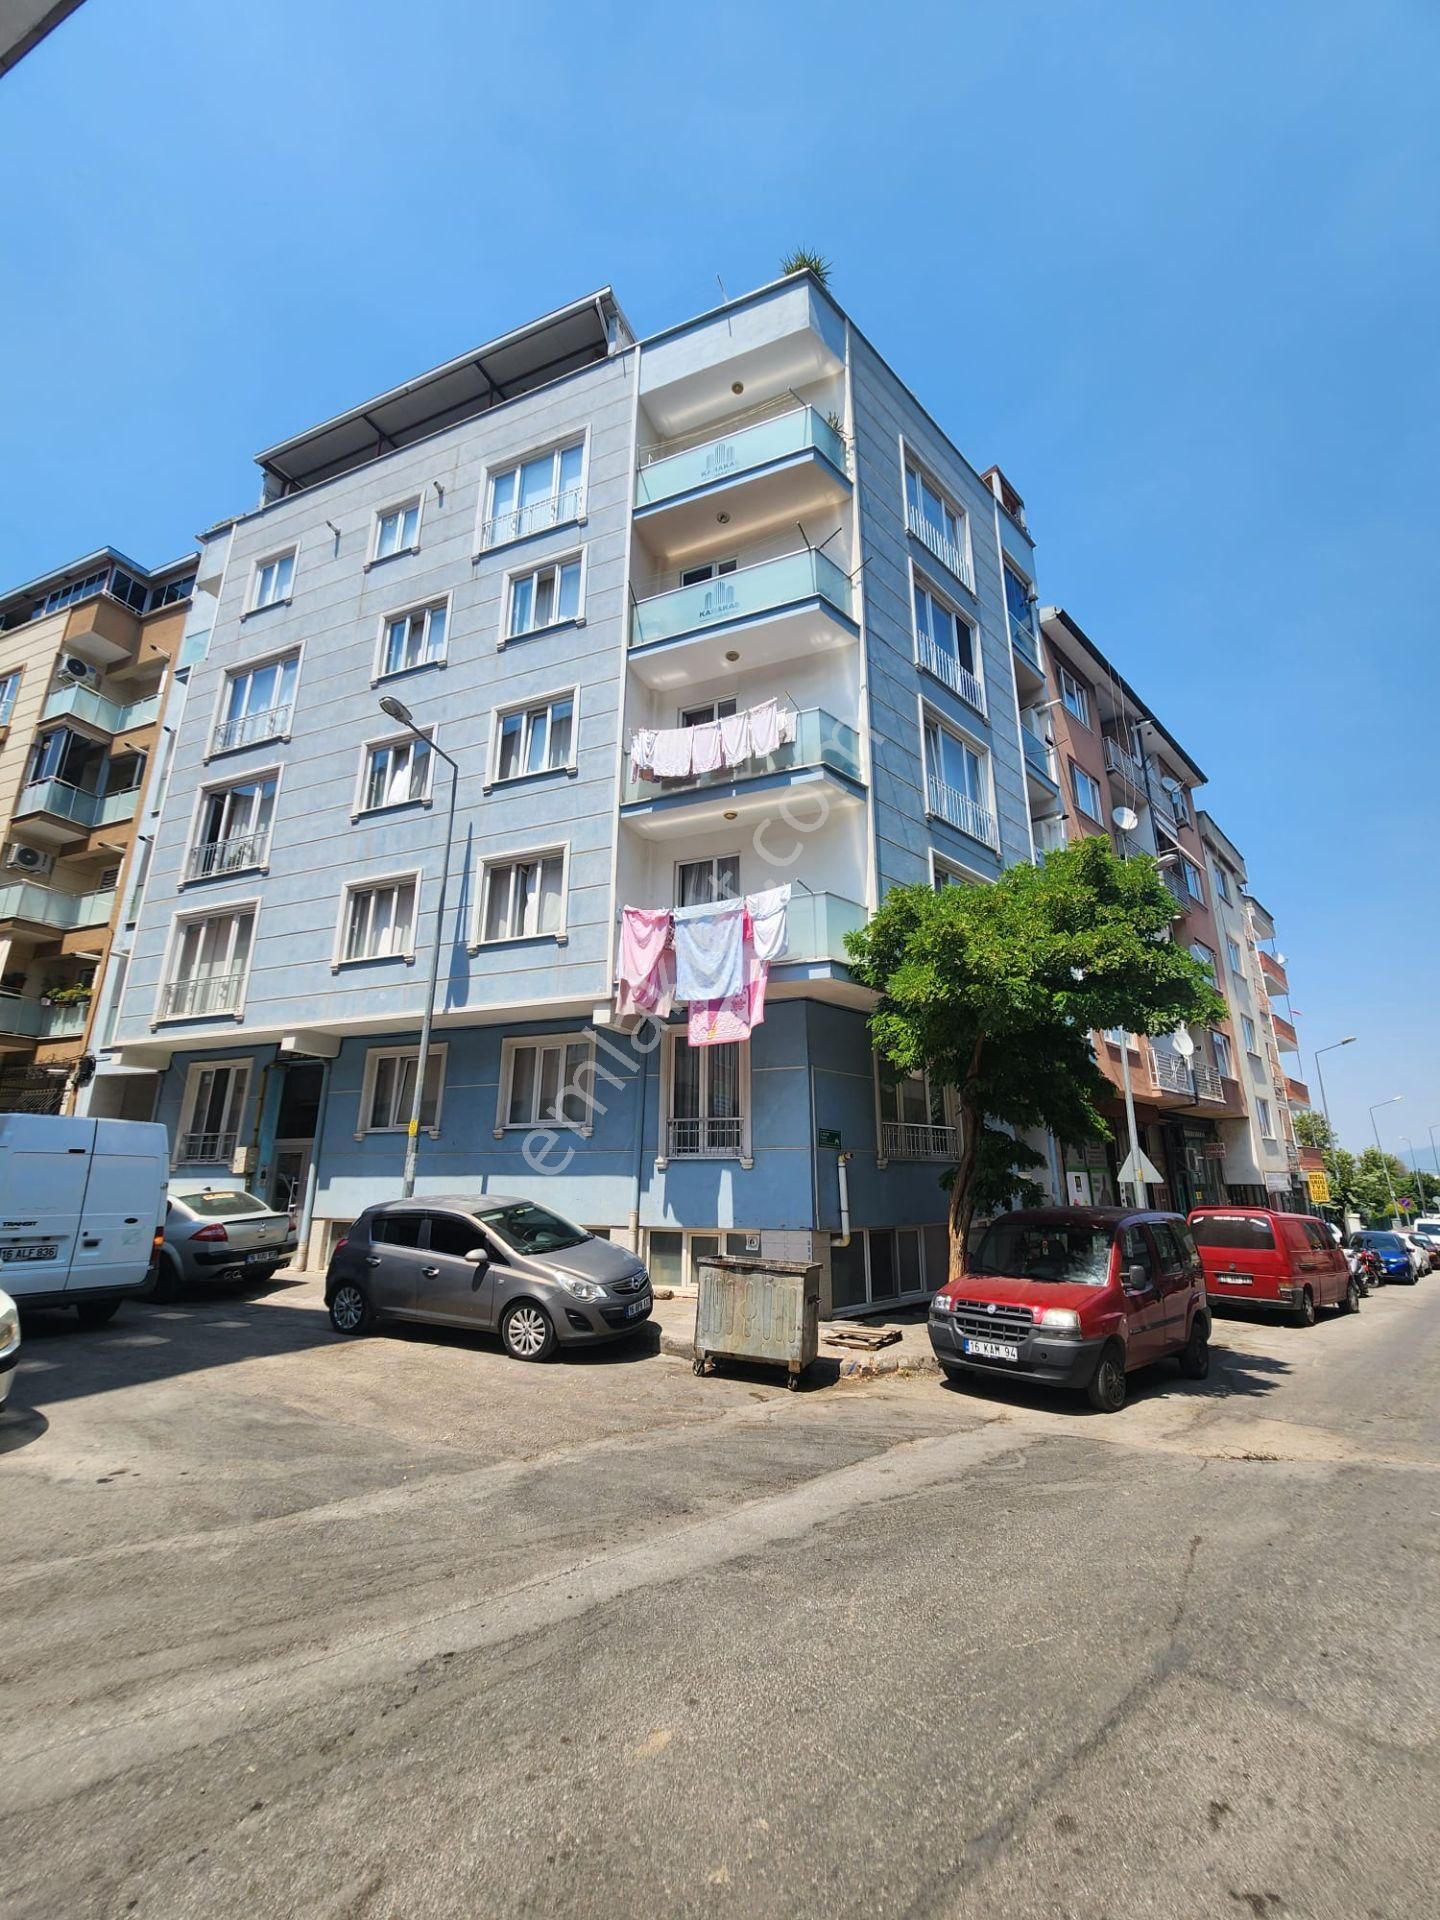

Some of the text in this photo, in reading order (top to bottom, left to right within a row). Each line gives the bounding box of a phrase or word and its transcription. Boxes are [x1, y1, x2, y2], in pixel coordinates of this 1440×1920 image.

[2, 1248, 55, 1258] 16 ALF 836
[970, 1341, 1017, 1359] 16 KAM 94
